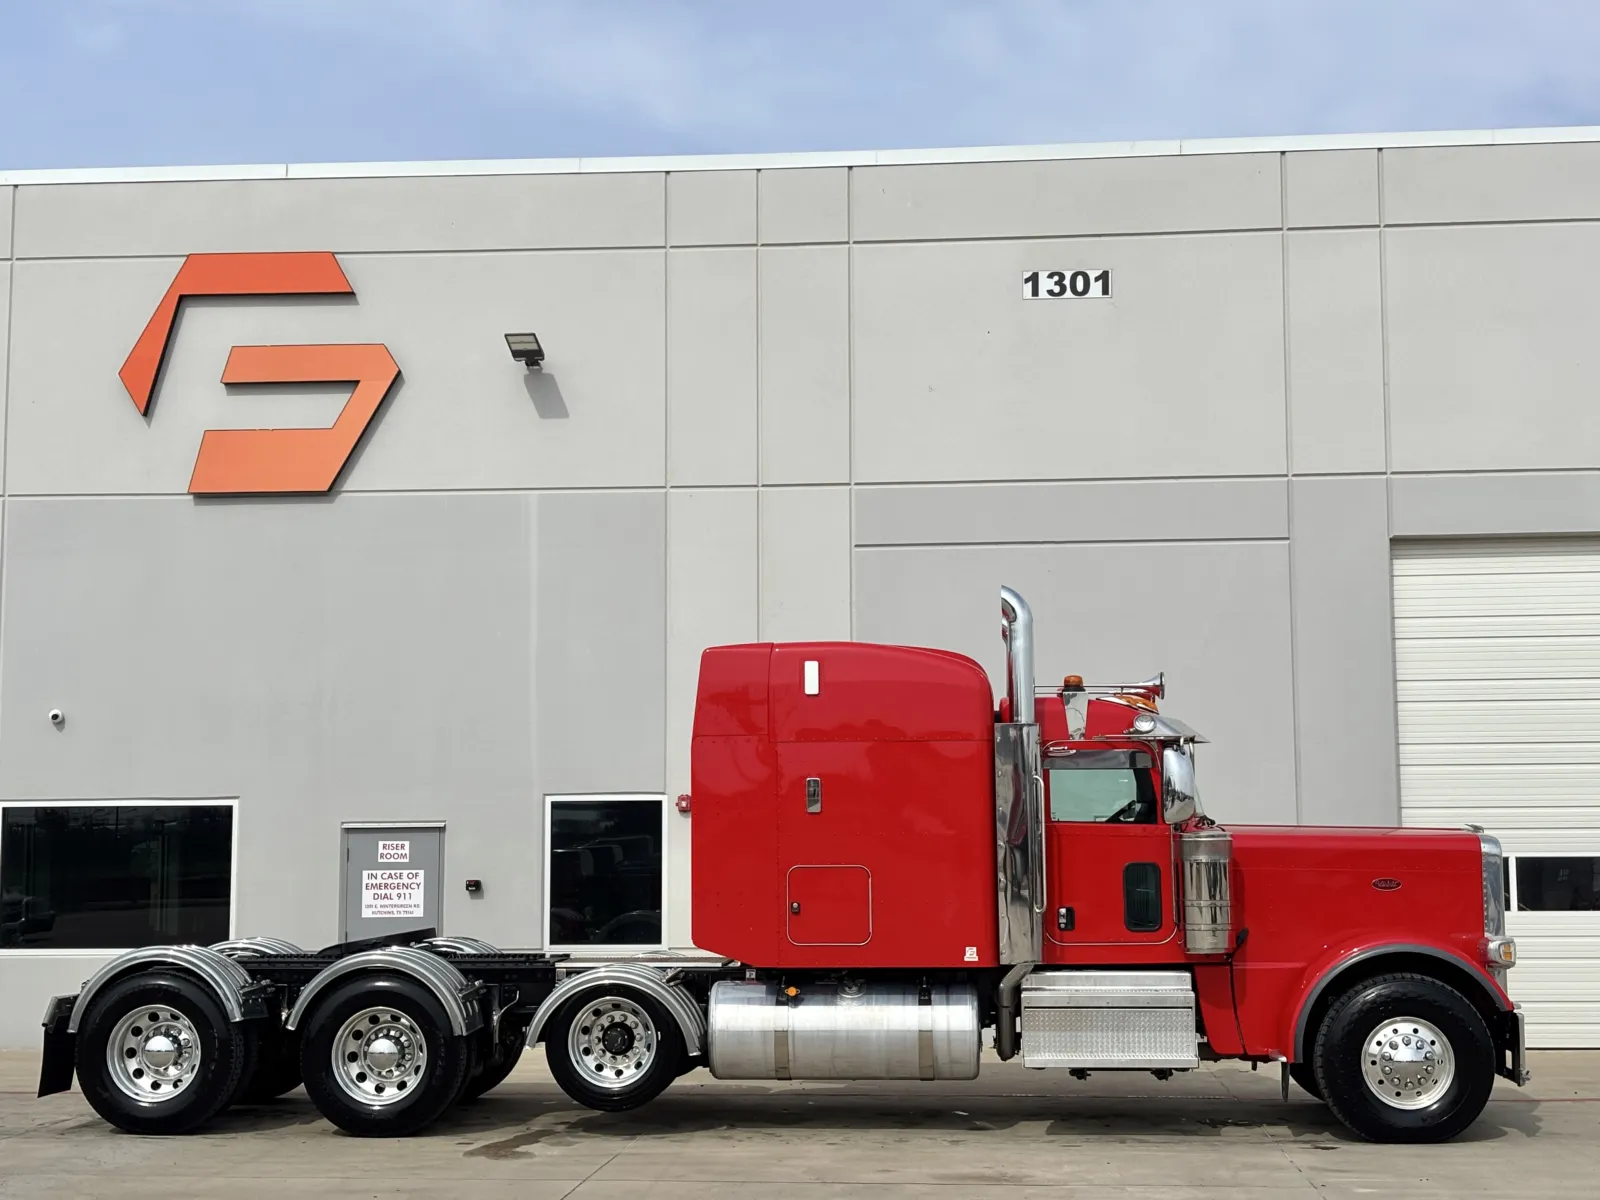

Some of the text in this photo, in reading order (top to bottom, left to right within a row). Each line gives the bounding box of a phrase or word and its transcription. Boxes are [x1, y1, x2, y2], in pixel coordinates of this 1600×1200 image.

[1024, 270, 1109, 297] 1301
[382, 843, 406, 851] RISER
[379, 852, 408, 860] ROOM
[367, 872, 420, 880] IN CASE OF
[365, 882, 422, 891] EMERGENCY
[372, 892, 412, 901] DIAL 911
